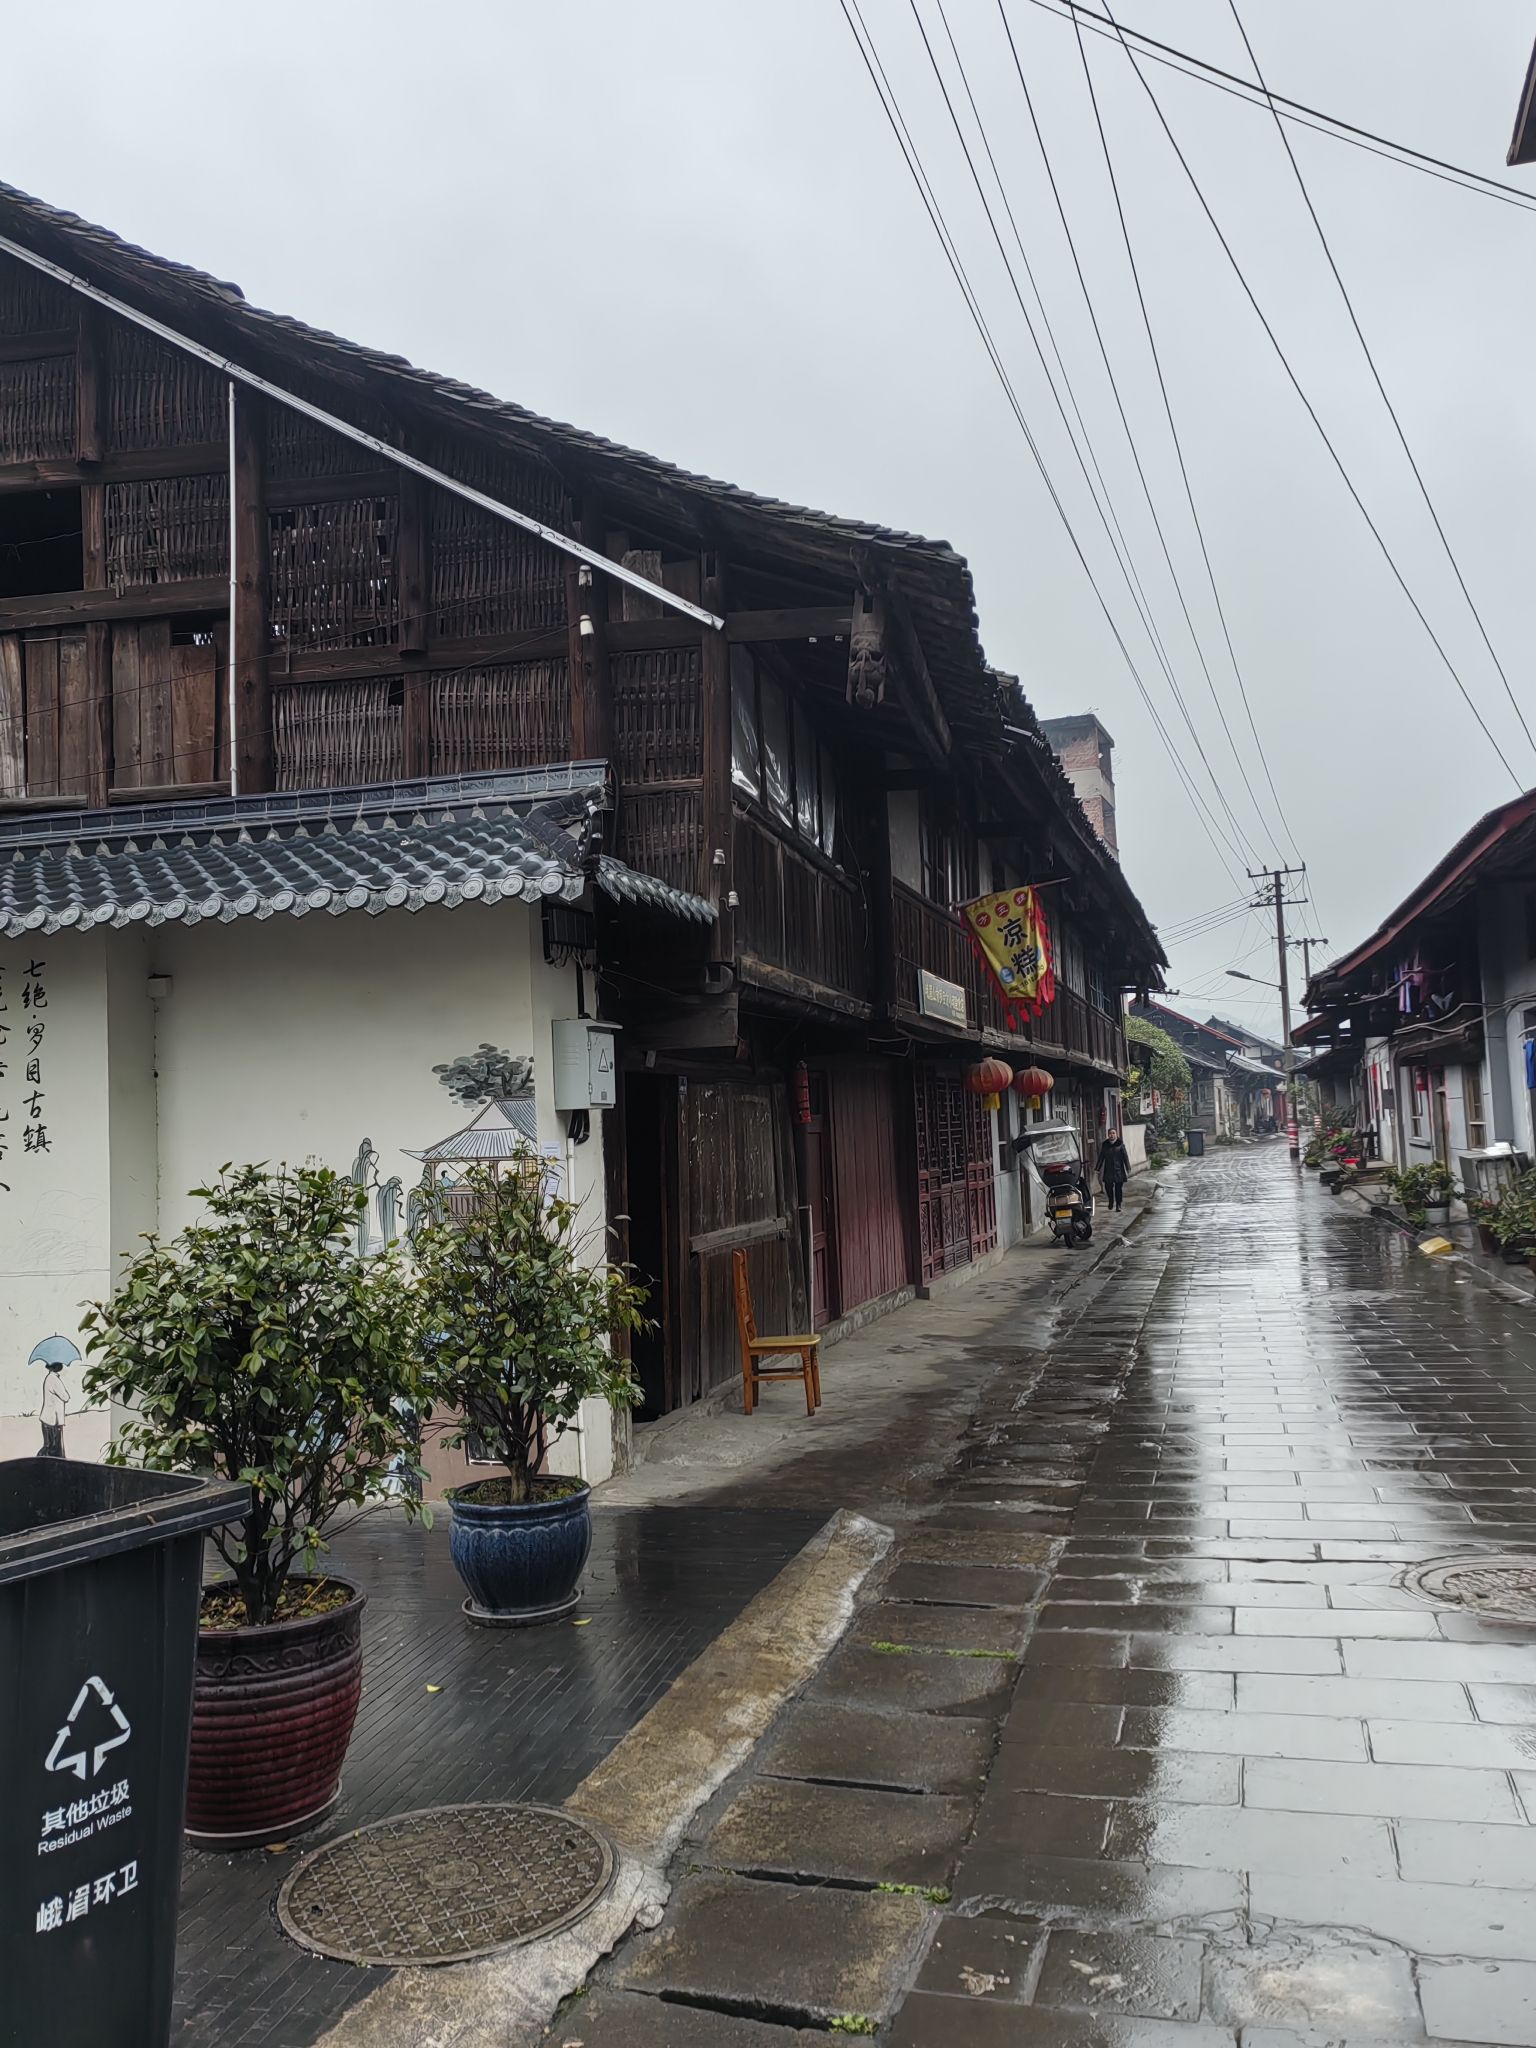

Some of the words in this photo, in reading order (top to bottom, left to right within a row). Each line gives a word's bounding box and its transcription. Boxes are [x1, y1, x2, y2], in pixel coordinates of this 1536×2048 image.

[37, 1822, 94, 1856] Residual
[96, 1805, 132, 1831] Waste
[41, 1778, 130, 1837] 其他垃圾
[36, 1860, 138, 1933] 峨眉环卫
